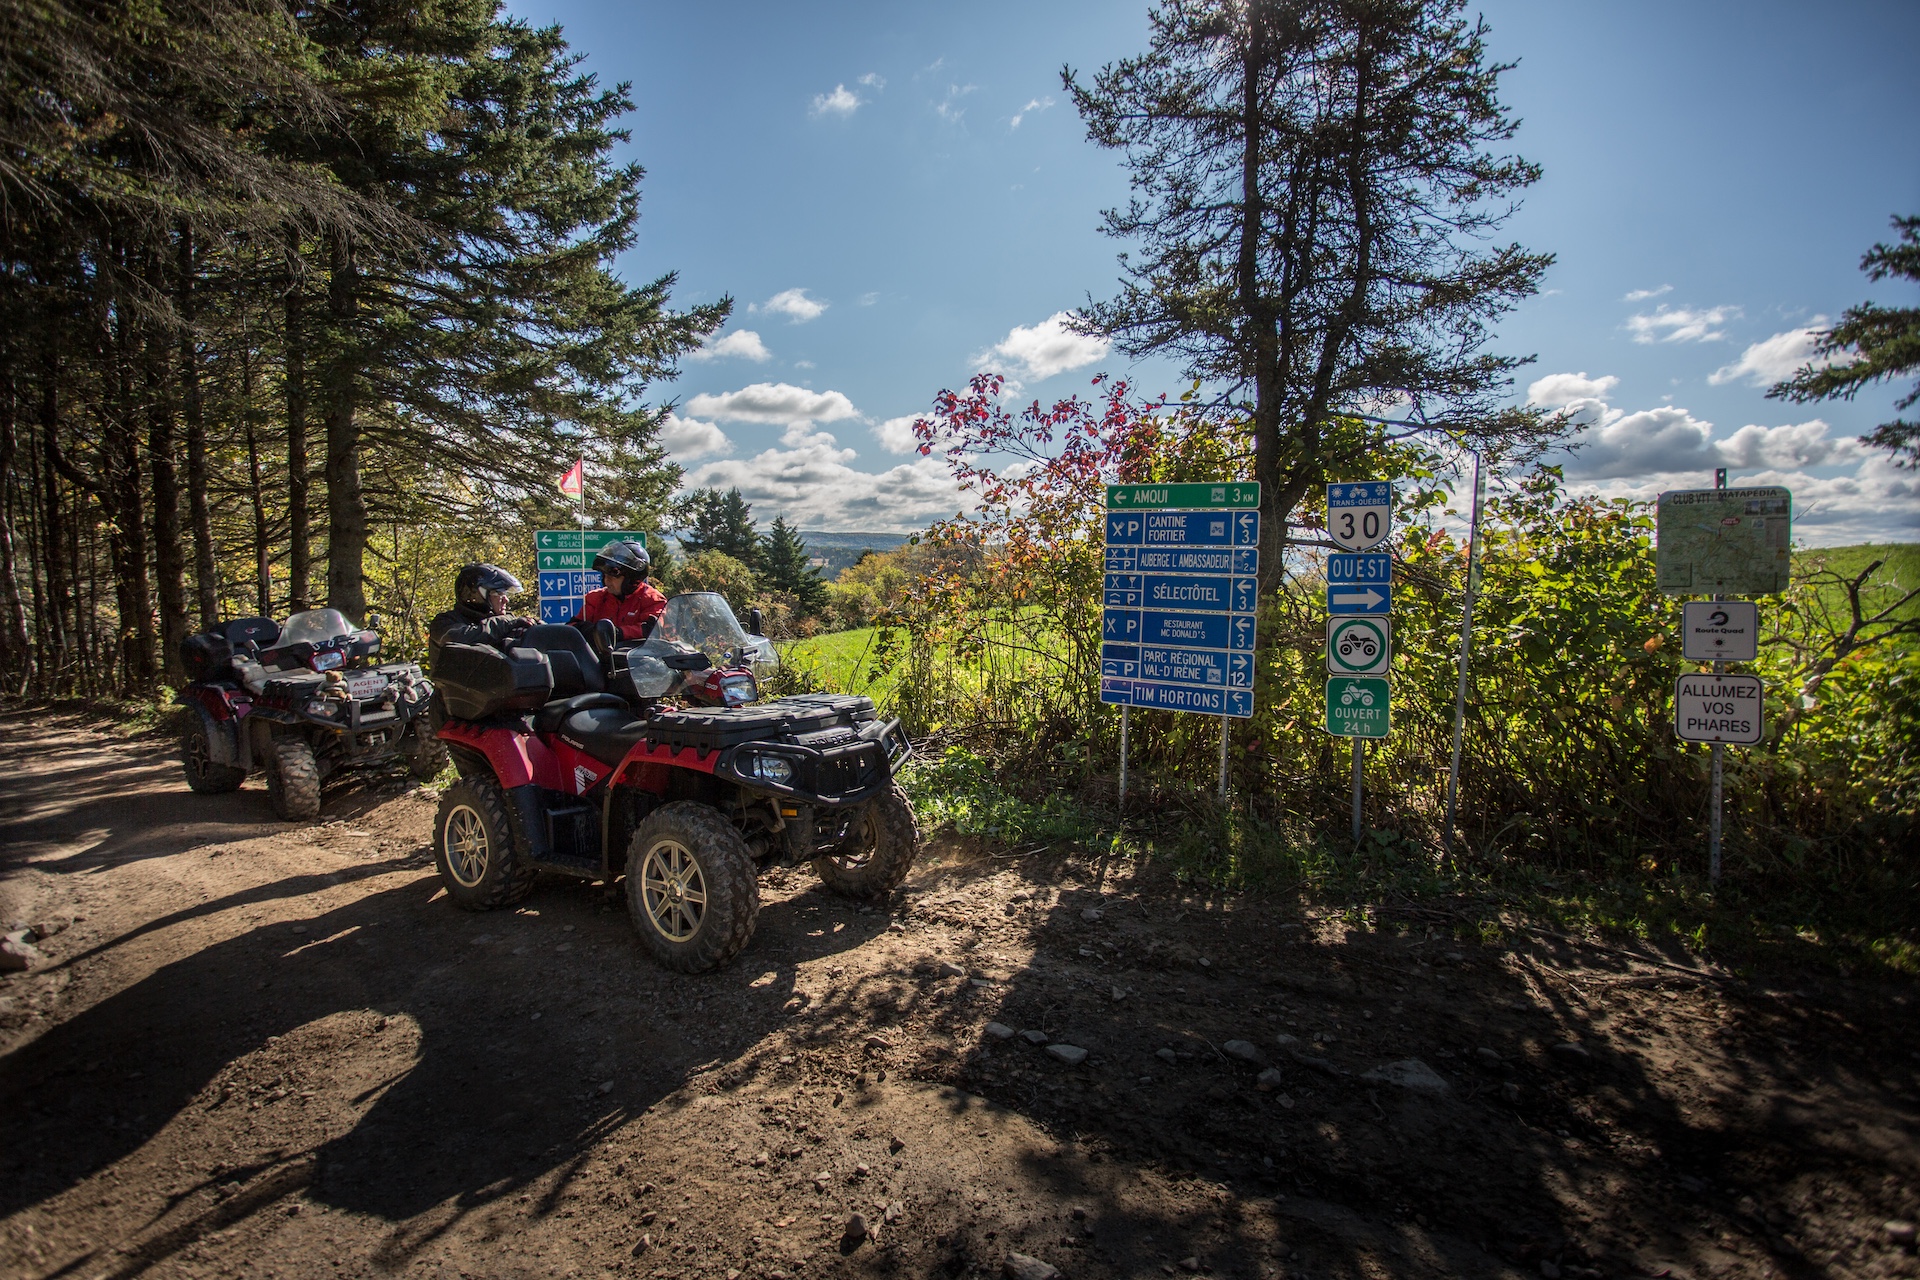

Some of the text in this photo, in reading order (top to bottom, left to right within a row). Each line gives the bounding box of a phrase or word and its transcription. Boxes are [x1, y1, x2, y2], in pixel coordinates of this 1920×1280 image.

[1133, 489, 1168, 503] AMQUI
[1233, 488, 1240, 502] 3
[1332, 498, 1386, 506] TRANS-QUÉBEC
[1673, 490, 1777, 504] CLUB VTT MATAPÉDIA
[1150, 516, 1187, 527] CANTINE
[1340, 511, 1379, 540] 30
[1128, 521, 1139, 536] P
[1149, 530, 1185, 541] FORTIER
[1242, 530, 1249, 544] 3
[1140, 554, 1170, 567] AUBERGE
[1244, 563, 1248, 571] 2
[1333, 559, 1386, 578] OUEST
[557, 579, 566, 590] P
[1127, 593, 1136, 604] P
[1153, 583, 1220, 601] SÉLECTÔTEL
[1239, 596, 1246, 610] 3
[560, 607, 568, 616] P
[1127, 620, 1137, 633] P
[1164, 620, 1203, 629] RESTAURANT
[1236, 634, 1244, 648] 3
[1144, 651, 1216, 667] PARC RÉGIONAL
[1124, 663, 1134, 676] P
[354, 679, 384, 687] AGENT
[1231, 672, 1245, 686] 12
[1135, 687, 1219, 708] TIM HORTONS
[1682, 684, 1756, 698] ALLUMEZ
[1237, 704, 1242, 714] 3
[1335, 707, 1380, 720] OUVERT
[1702, 702, 1734, 714] VOS
[1344, 722, 1370, 733] 24 h
[1688, 718, 1750, 733] PHARES
